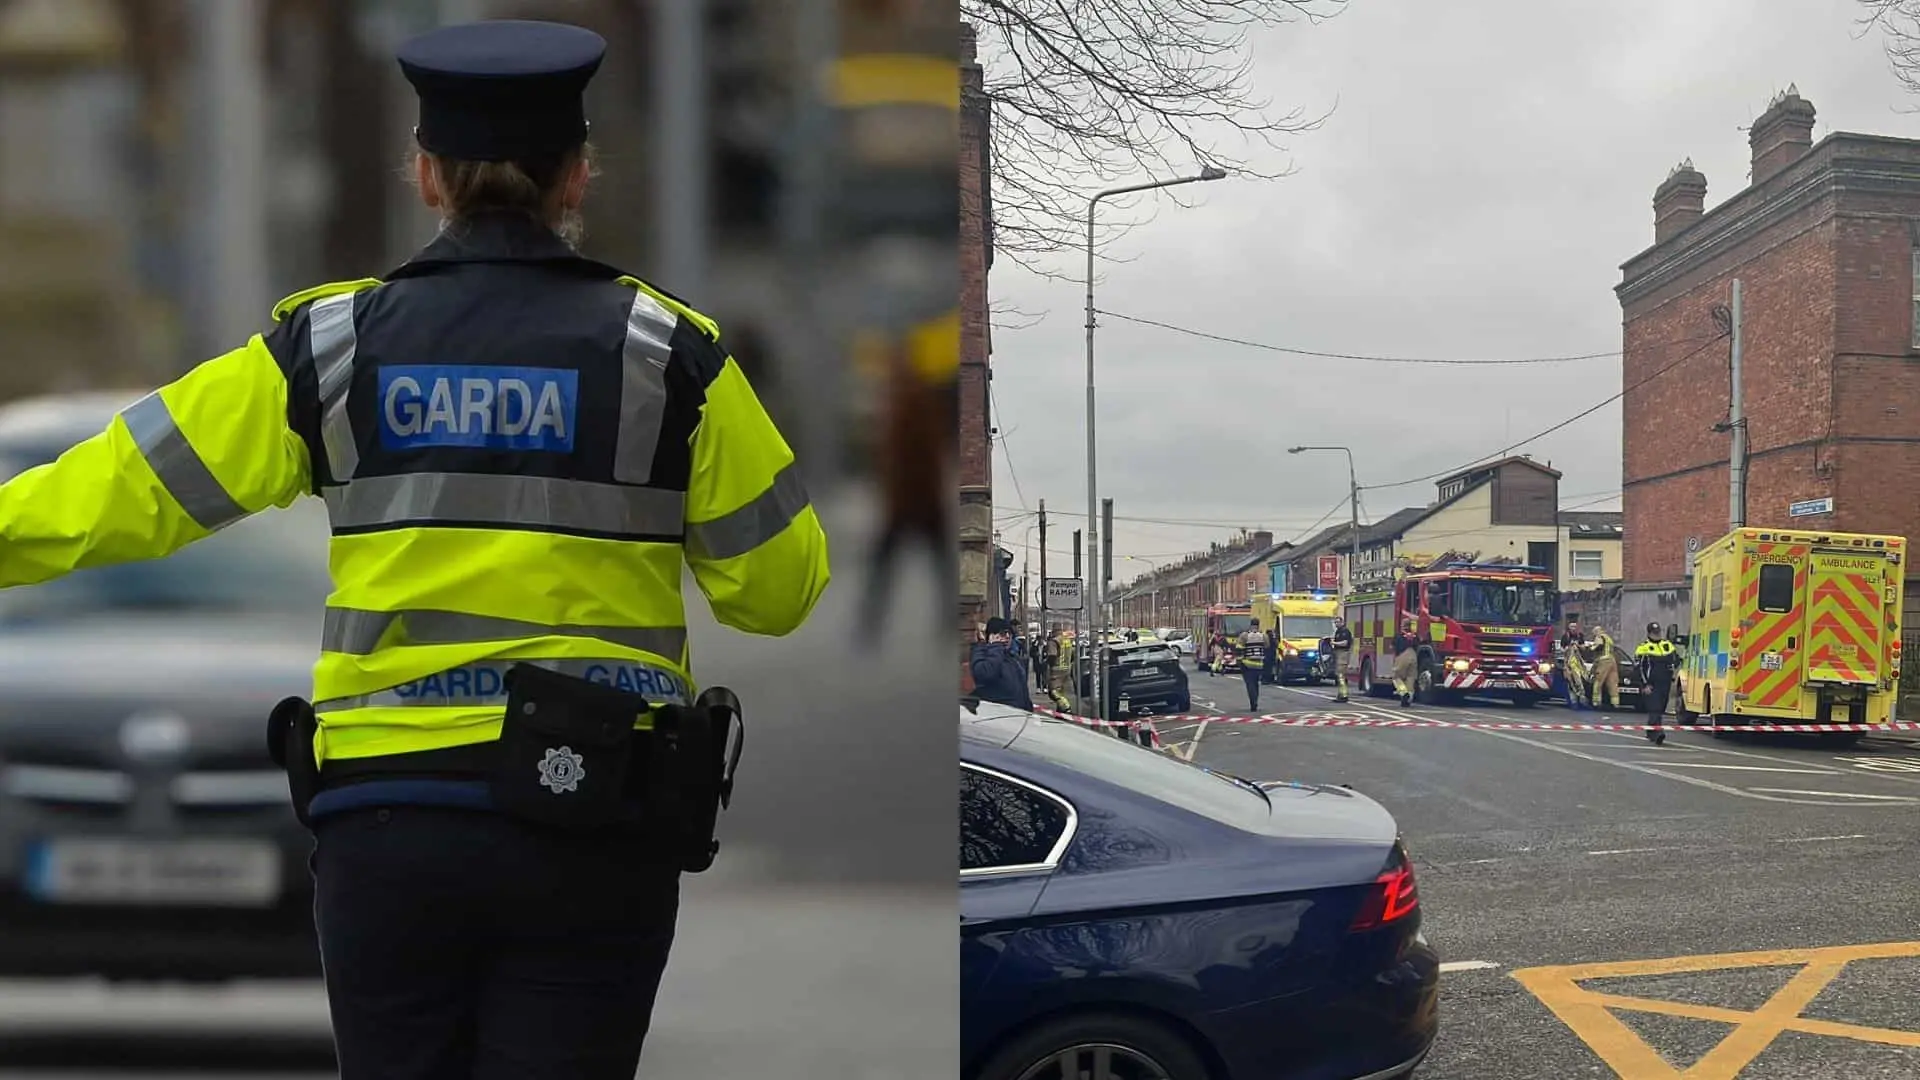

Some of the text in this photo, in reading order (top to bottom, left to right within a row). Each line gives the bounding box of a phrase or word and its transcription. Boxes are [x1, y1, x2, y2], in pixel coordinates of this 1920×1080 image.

[384, 376, 567, 438] GARDA
[1752, 553, 1803, 565] EMERGENCY
[1821, 558, 1876, 569] AMBULANCE
[1049, 589, 1078, 597] RAMPS
[394, 668, 507, 697] GARD
